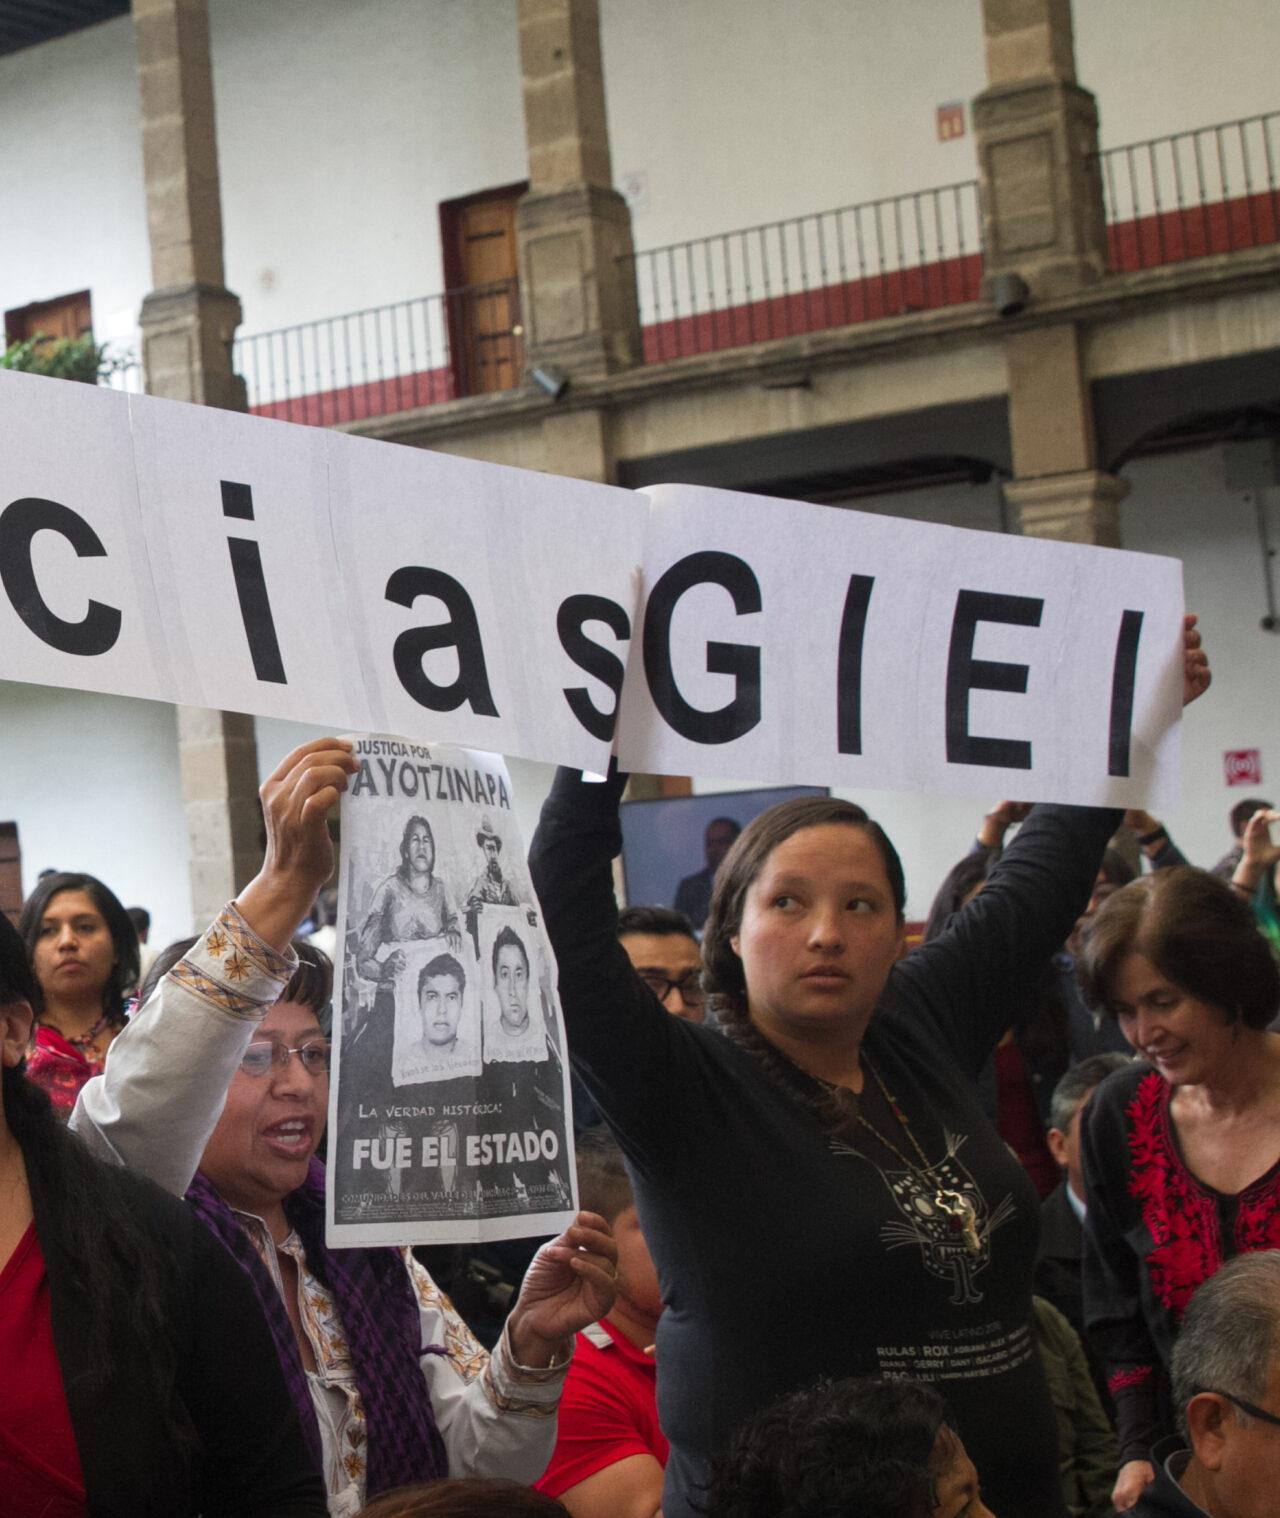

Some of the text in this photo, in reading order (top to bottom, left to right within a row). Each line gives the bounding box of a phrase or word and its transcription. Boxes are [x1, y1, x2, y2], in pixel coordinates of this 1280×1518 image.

[356, 740, 432, 760] JUSTICIA POR
[352, 758, 510, 810] AYOTZINAPA
[386, 1106, 436, 1118] VERDAD
[353, 1129, 559, 1170] FUE EL ESTADO
[876, 1346, 916, 1356] RULAS
[923, 1346, 950, 1357] ROX
[913, 1359, 944, 1368] GERRY
